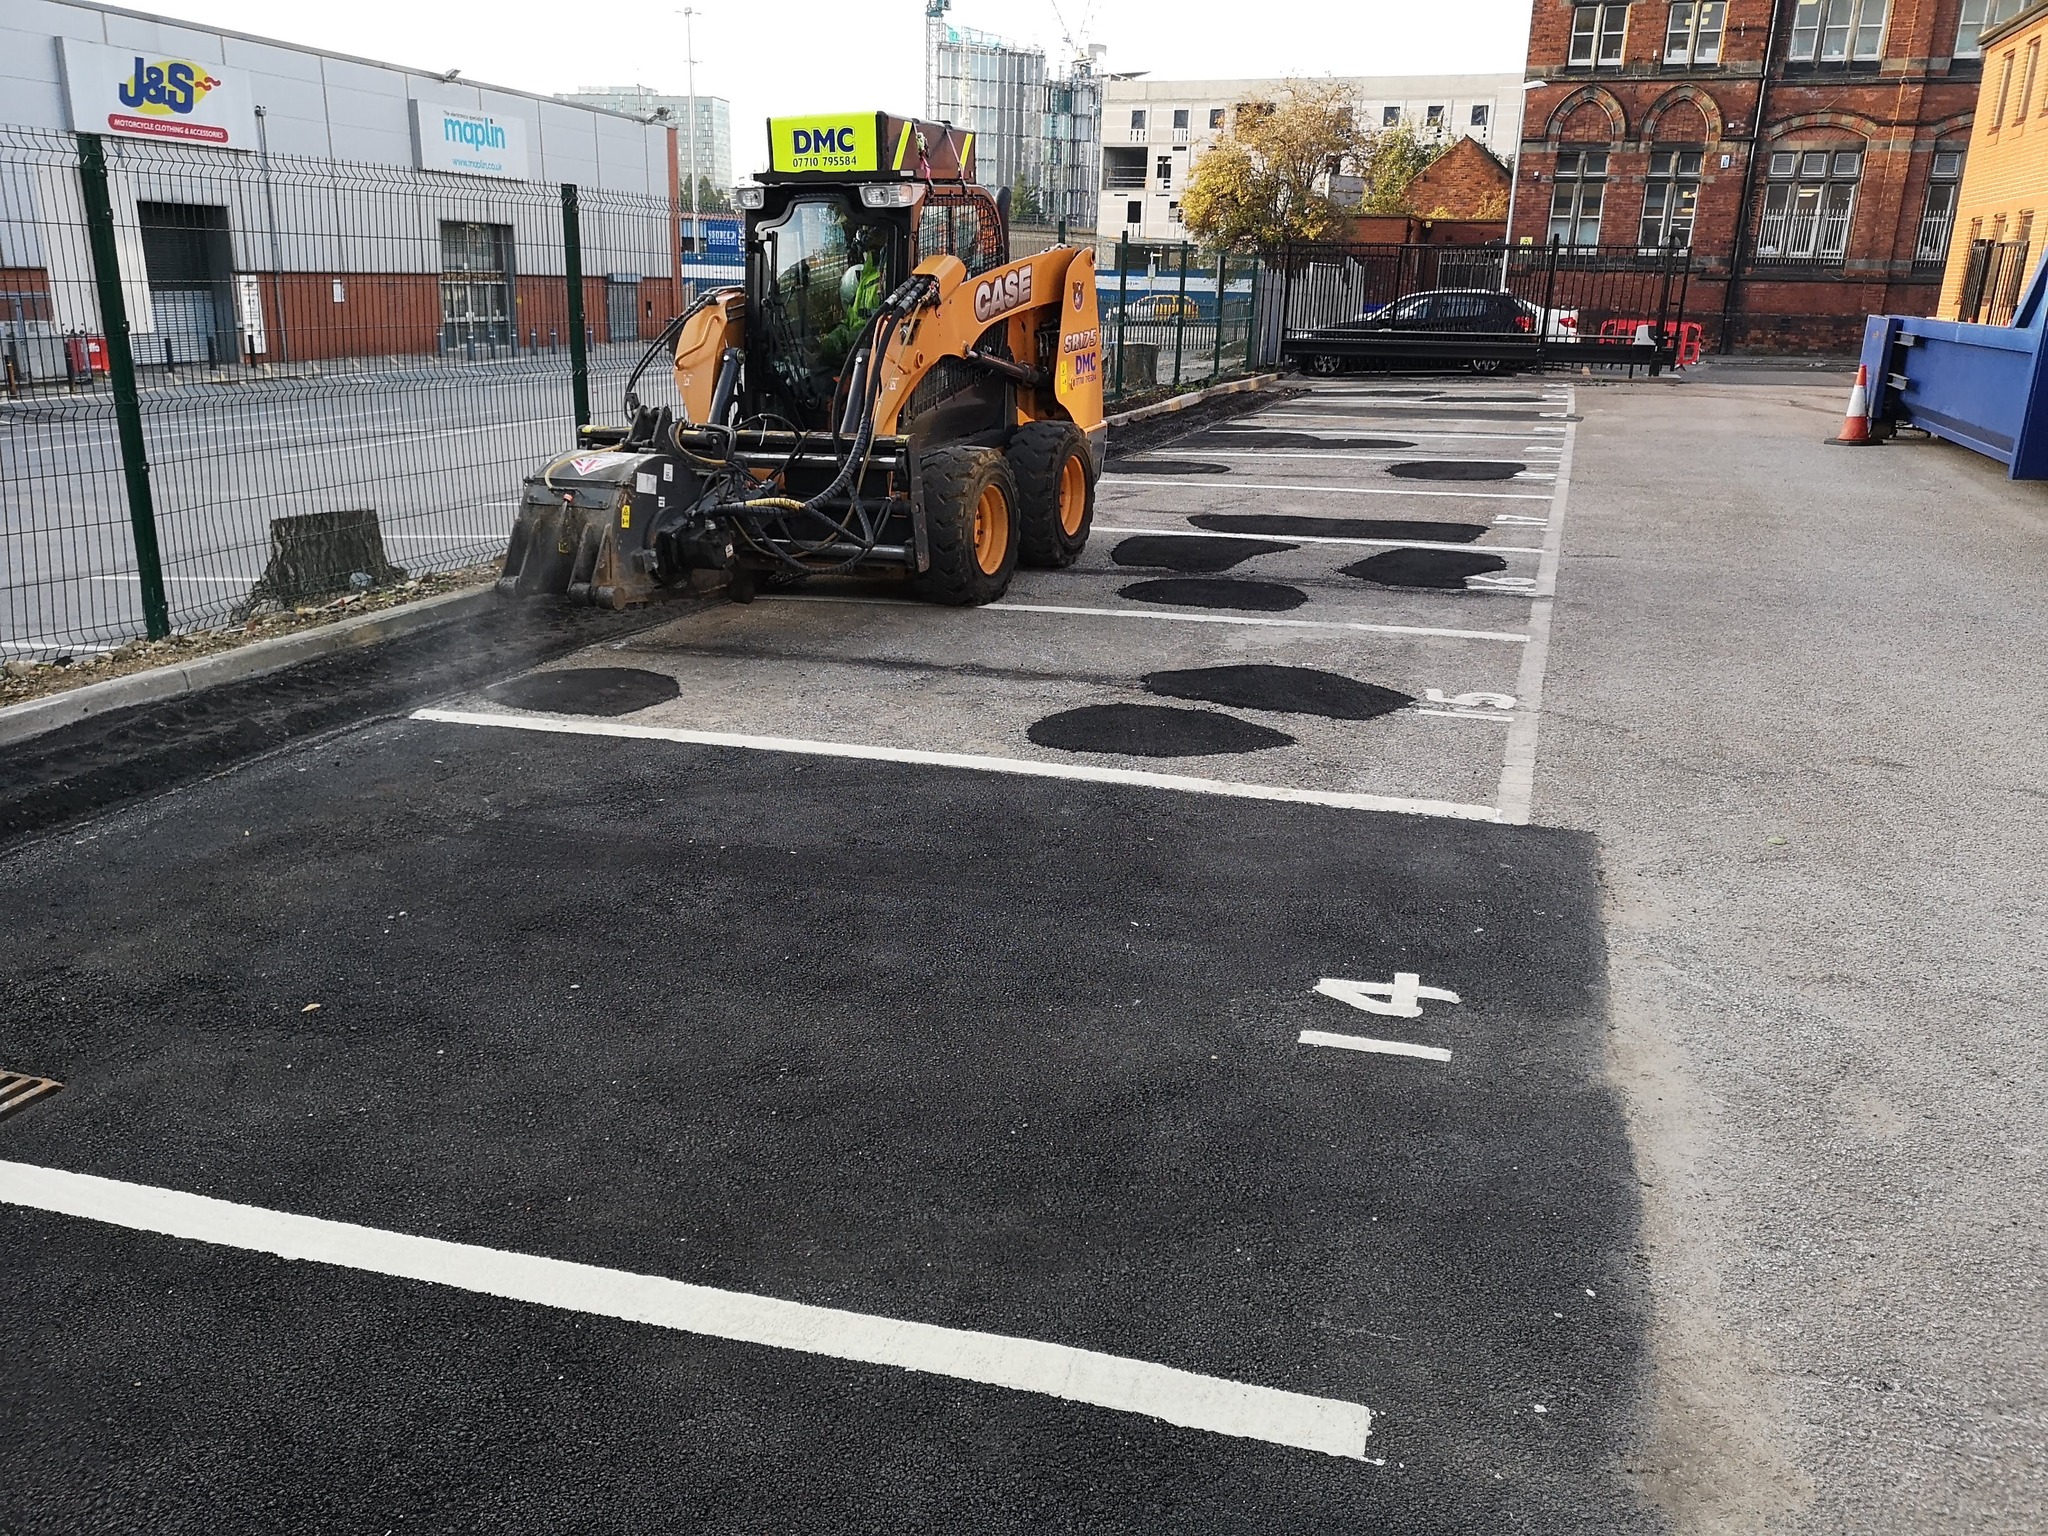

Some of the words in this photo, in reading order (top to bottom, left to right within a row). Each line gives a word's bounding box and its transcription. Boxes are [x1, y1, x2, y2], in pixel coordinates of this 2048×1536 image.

[118, 56, 195, 115] J&S
[113, 118, 155, 132] MOTORCYCLE
[154, 123, 184, 135] CLOTHING
[184, 127, 190, 135] &
[190, 129, 224, 139] ACCESSORIES
[443, 117, 506, 151] maplin
[792, 127, 855, 155] DMC
[792, 157, 819, 168] 07710
[822, 155, 857, 167] 795584
[974, 263, 1032, 323] CASE
[1063, 328, 1098, 354] SR175
[1075, 352, 1097, 375] DMC
[1463, 574, 1537, 593] 16
[1416, 688, 1518, 722] 15
[1298, 972, 1462, 1062] 14
